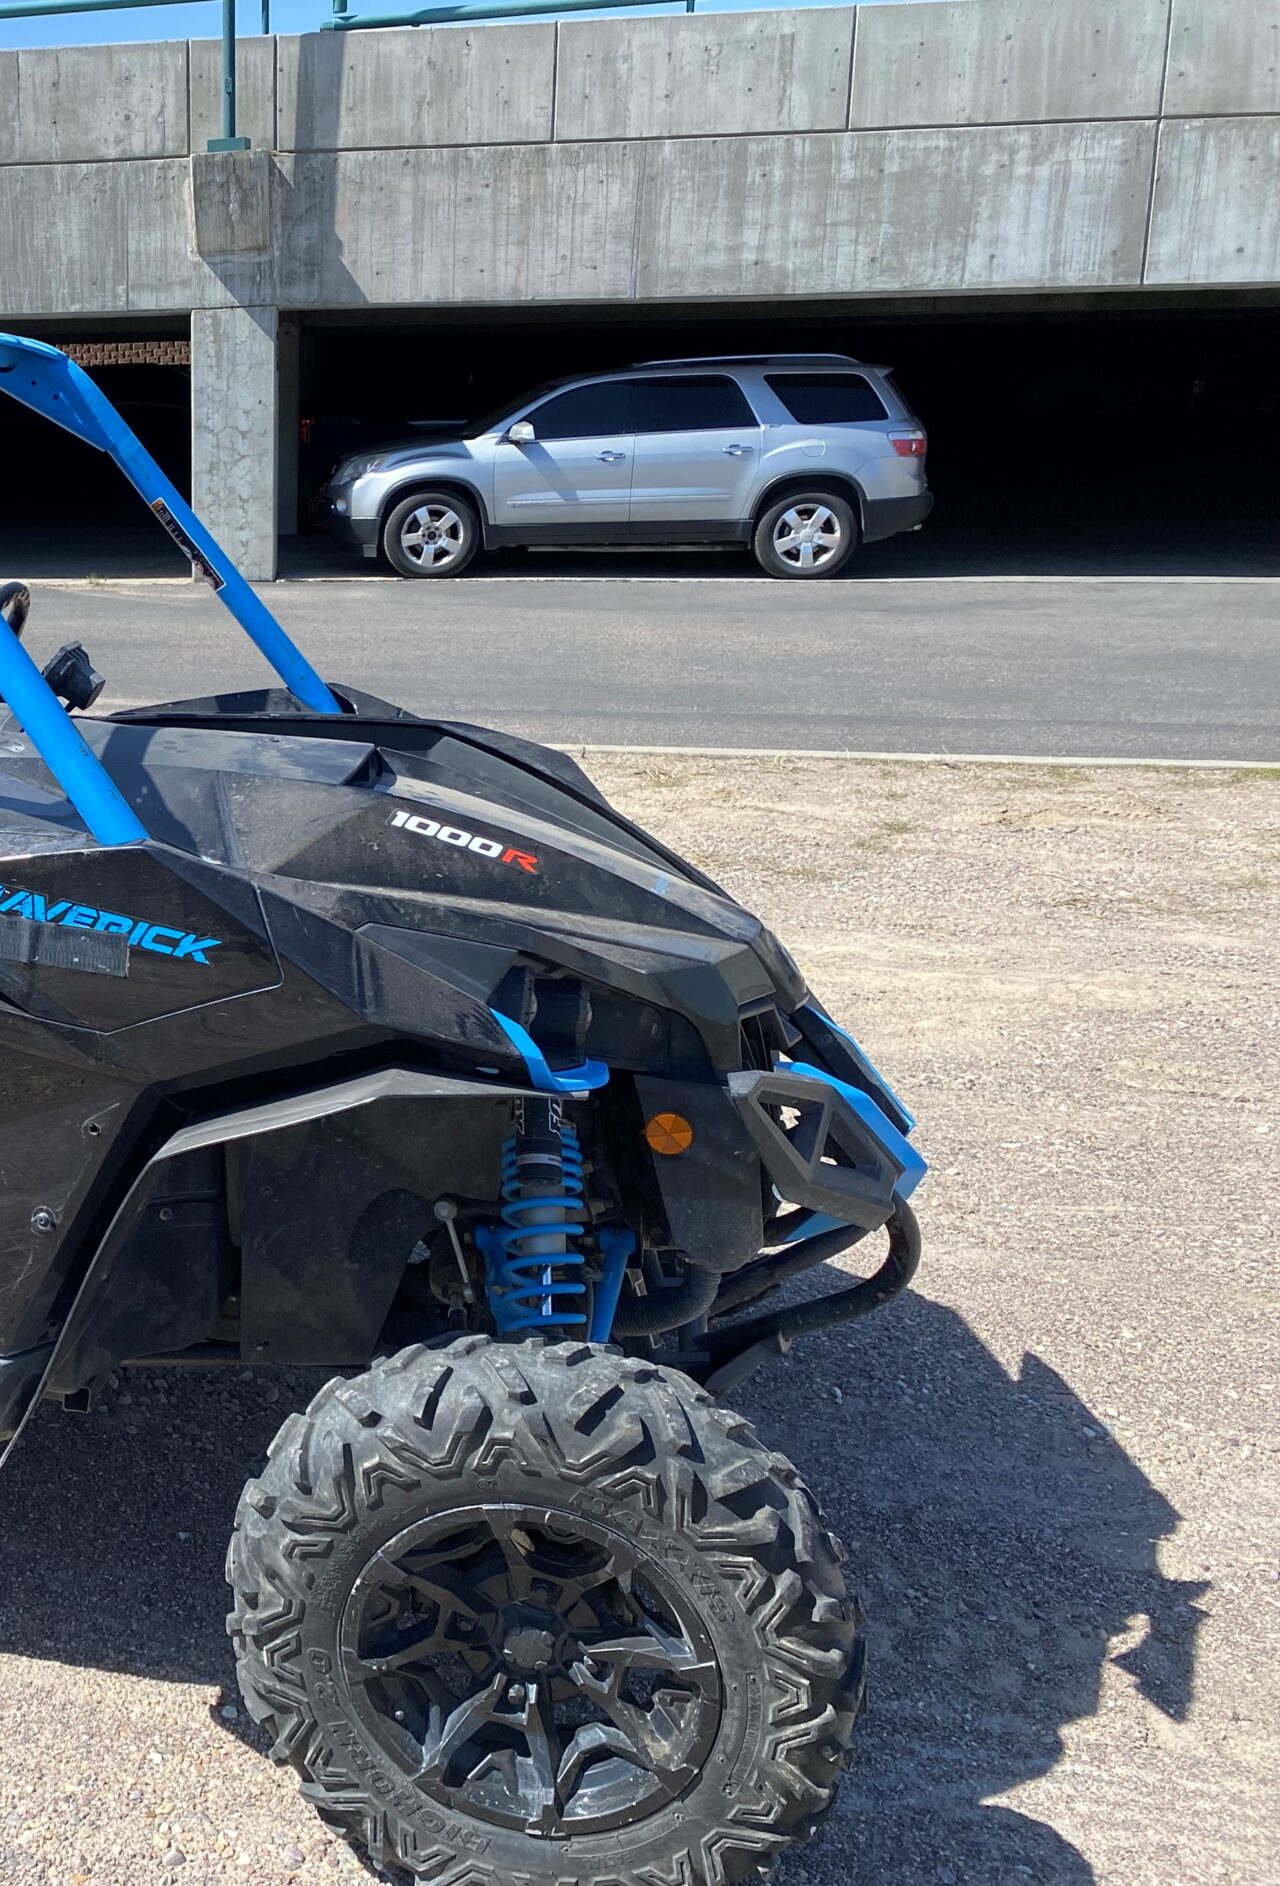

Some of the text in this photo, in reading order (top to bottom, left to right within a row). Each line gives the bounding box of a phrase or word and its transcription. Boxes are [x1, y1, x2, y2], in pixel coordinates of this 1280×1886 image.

[391, 810, 538, 873] 1000R
[568, 1490, 736, 1623] MAXXIS
[326, 1720, 494, 1855] BIGHORN
